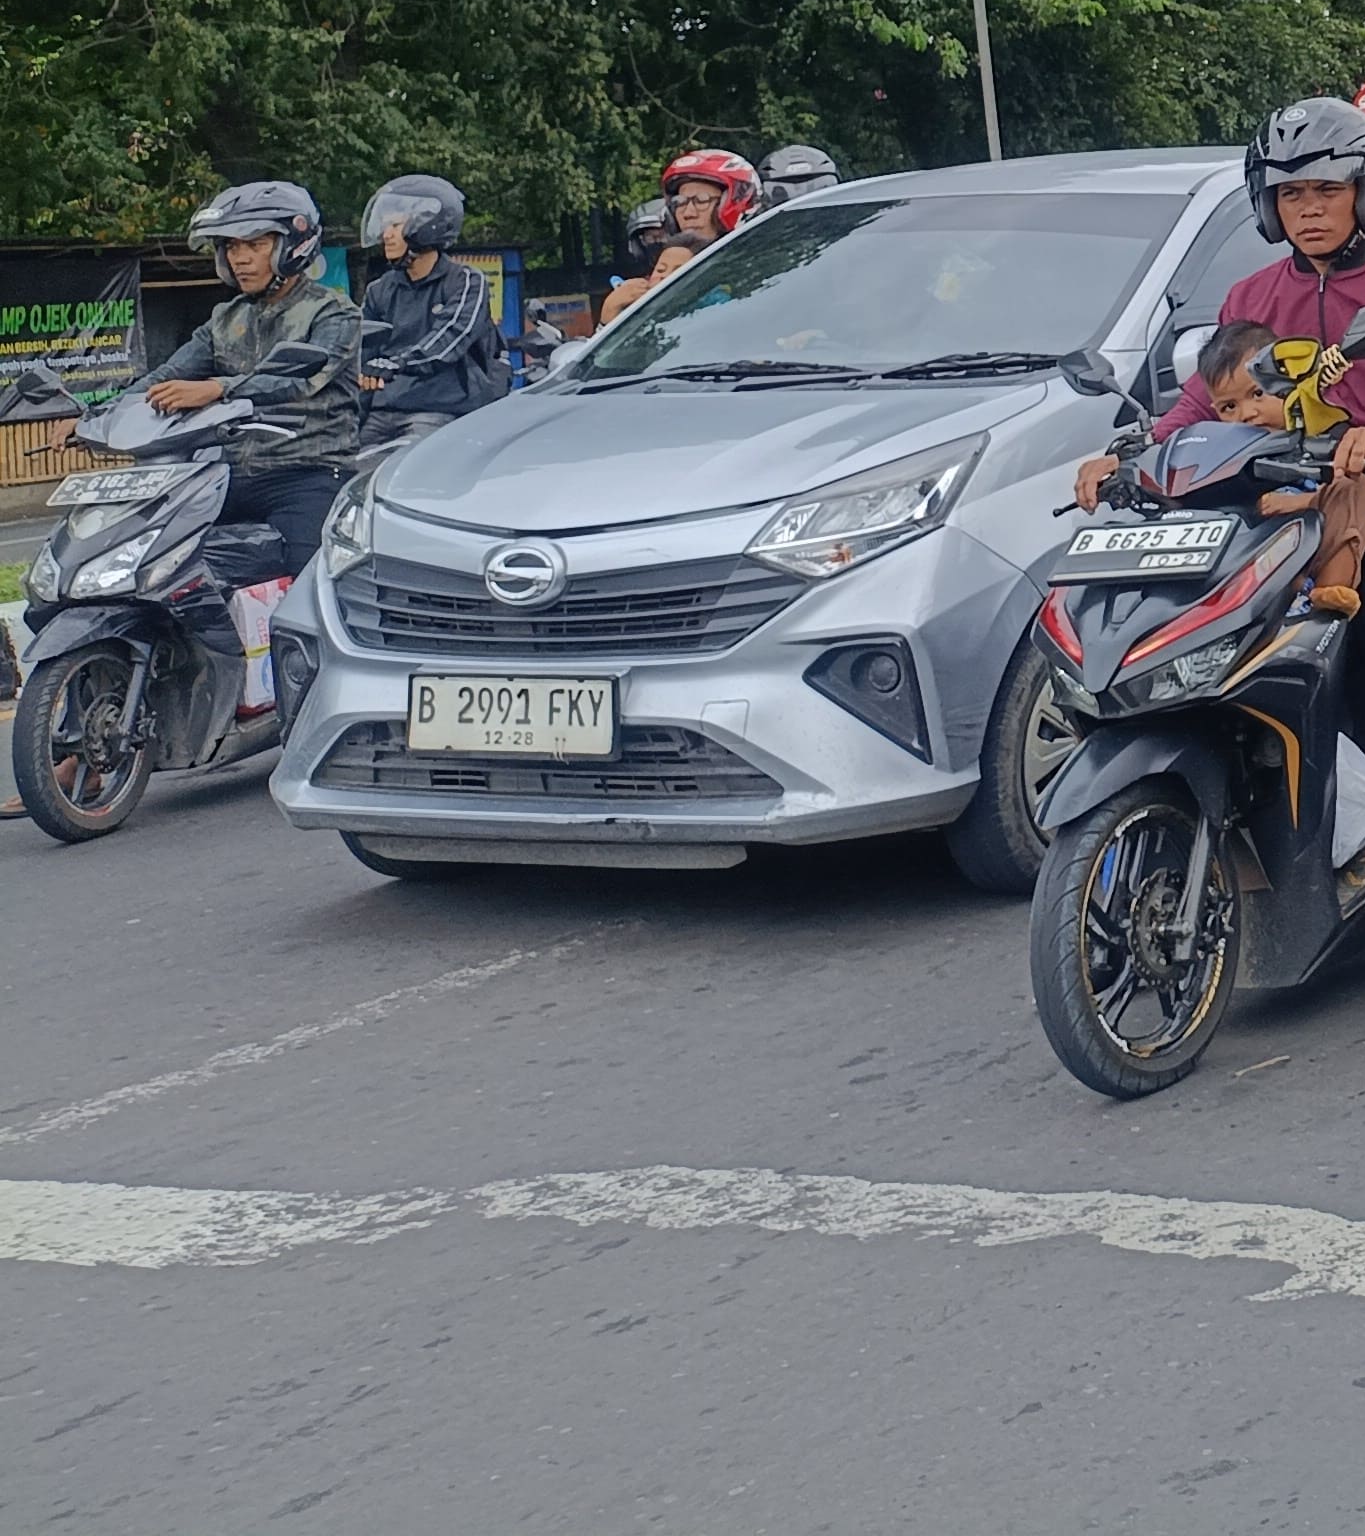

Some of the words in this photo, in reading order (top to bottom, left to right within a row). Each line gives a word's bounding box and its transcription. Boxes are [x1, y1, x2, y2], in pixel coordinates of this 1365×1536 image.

[30, 304, 72, 333] OJEK
[75, 299, 135, 331] ONLINE
[1076, 534, 1093, 552] B
[1106, 530, 1168, 549] 6625
[418, 686, 435, 723] B
[458, 687, 531, 725] 2991
[549, 688, 604, 727] FKY
